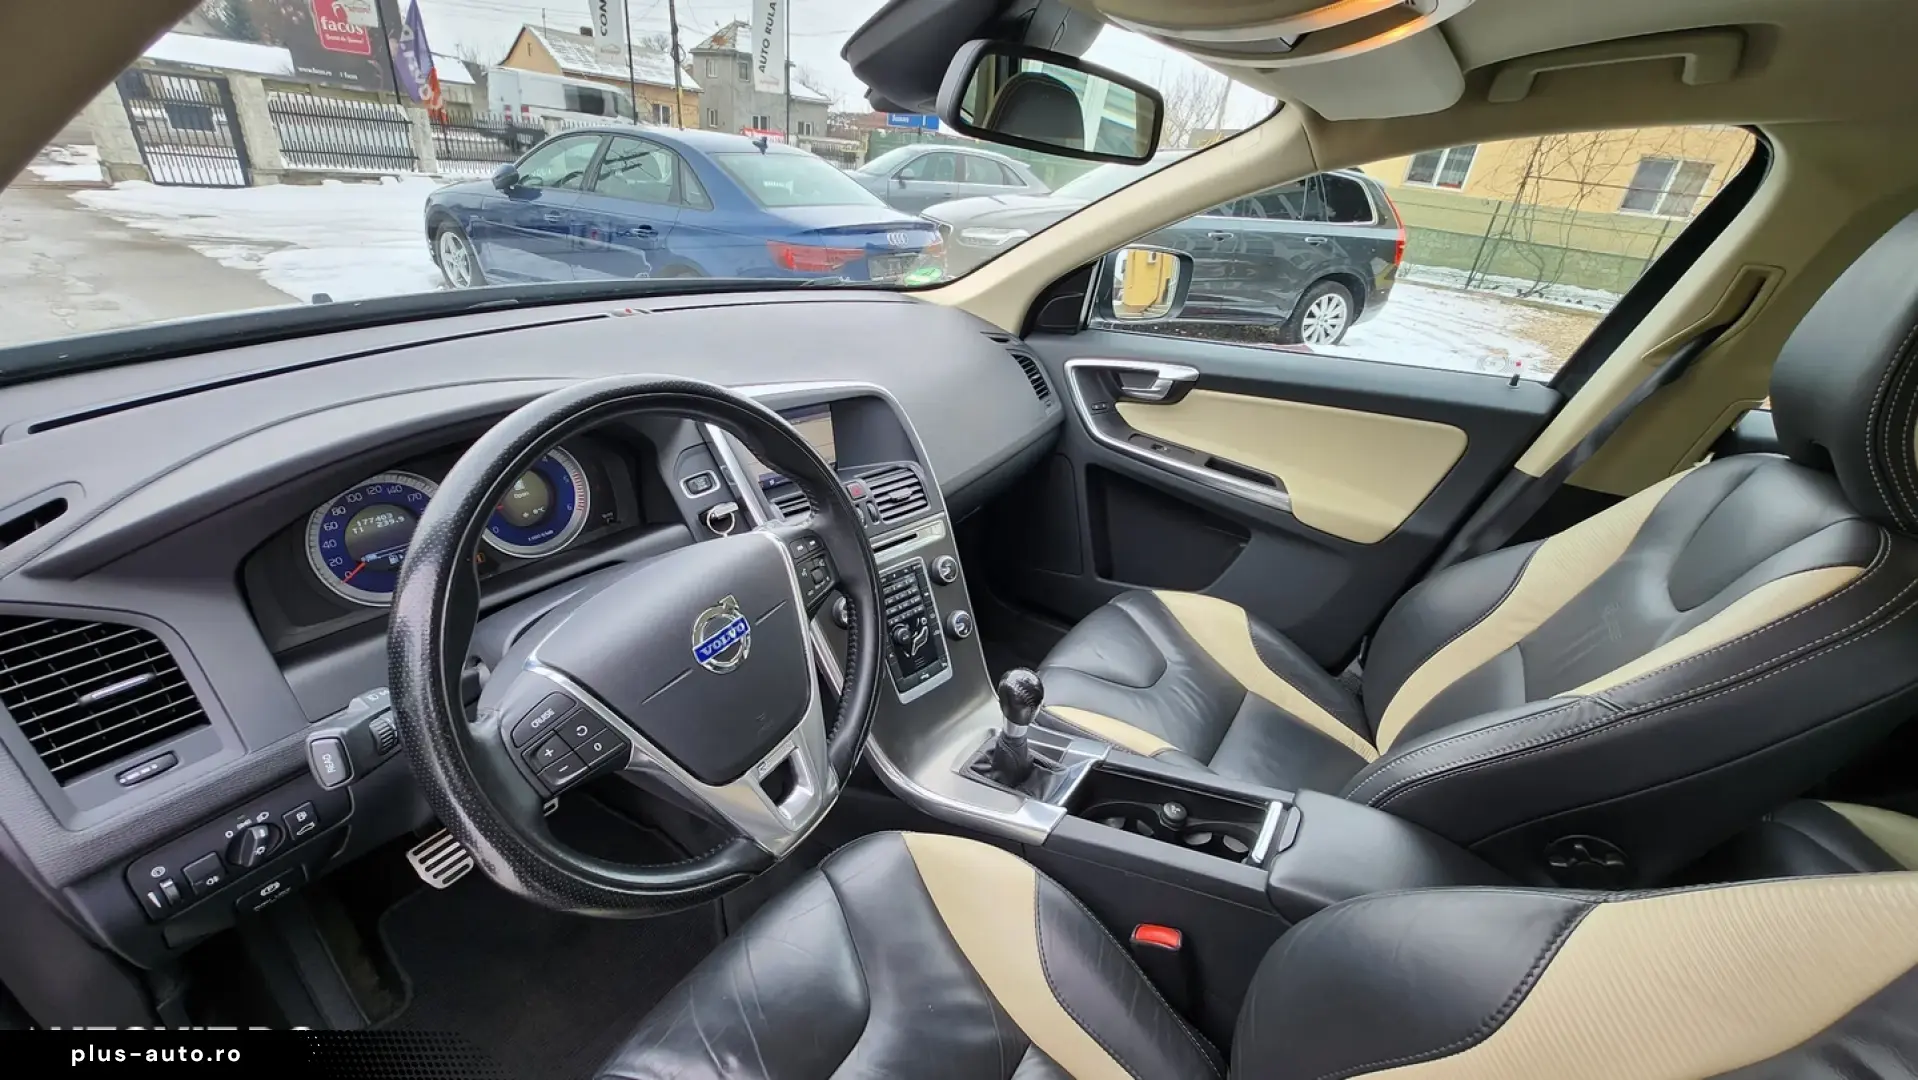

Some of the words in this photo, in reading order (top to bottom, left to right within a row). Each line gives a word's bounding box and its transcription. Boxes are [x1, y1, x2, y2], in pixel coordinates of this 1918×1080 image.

[764, 2, 777, 35] RULA
[320, 16, 364, 35] facos
[758, 41, 771, 74] AUTO
[366, 485, 383, 495] 120
[346, 493, 363, 503] 100
[331, 506, 346, 516] 80
[323, 521, 338, 531] 60
[322, 539, 337, 549] 40
[329, 557, 343, 567] 20
[701, 621, 746, 657] VOLVO
[530, 708, 555, 728] CRUISE
